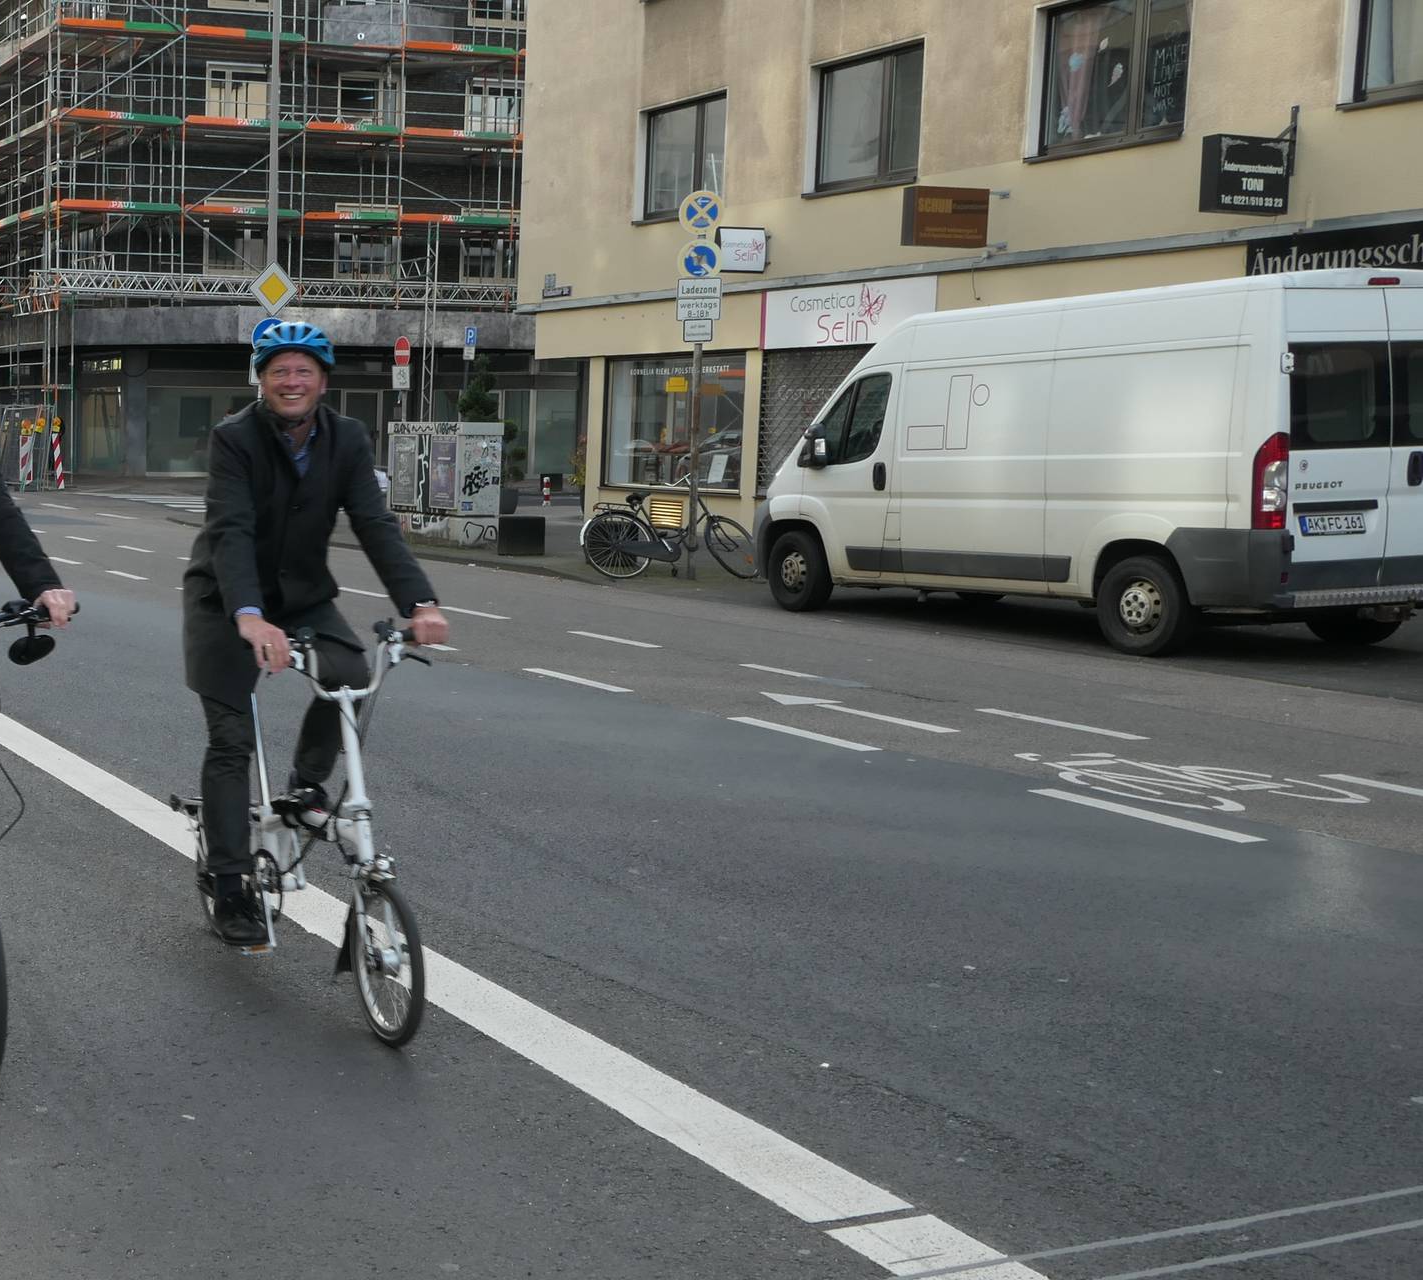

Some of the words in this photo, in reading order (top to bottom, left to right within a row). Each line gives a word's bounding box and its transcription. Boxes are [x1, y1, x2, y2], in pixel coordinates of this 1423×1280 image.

[452, 44, 474, 52] PAUL
[1153, 63, 1183, 84] LOVE
[1153, 82, 1173, 98] NOT
[1152, 97, 1176, 113] WAR
[110, 111, 134, 119] PAUL
[237, 118, 261, 126] PAUL
[1241, 177, 1264, 191] TONI
[112, 201, 135, 209] PAUL
[233, 206, 256, 214] PAUL
[442, 214, 464, 222] PAUL
[734, 249, 758, 262] Selin
[681, 286, 717, 295] Ladezone
[680, 302, 718, 310] werktags
[791, 292, 855, 313] Cosmetica
[817, 312, 868, 344] Selin
[1295, 481, 1343, 490] PEUGEOT
[1308, 518, 1322, 531] AK
[1327, 517, 1343, 530] FC
[1344, 516, 1364, 529] 161
